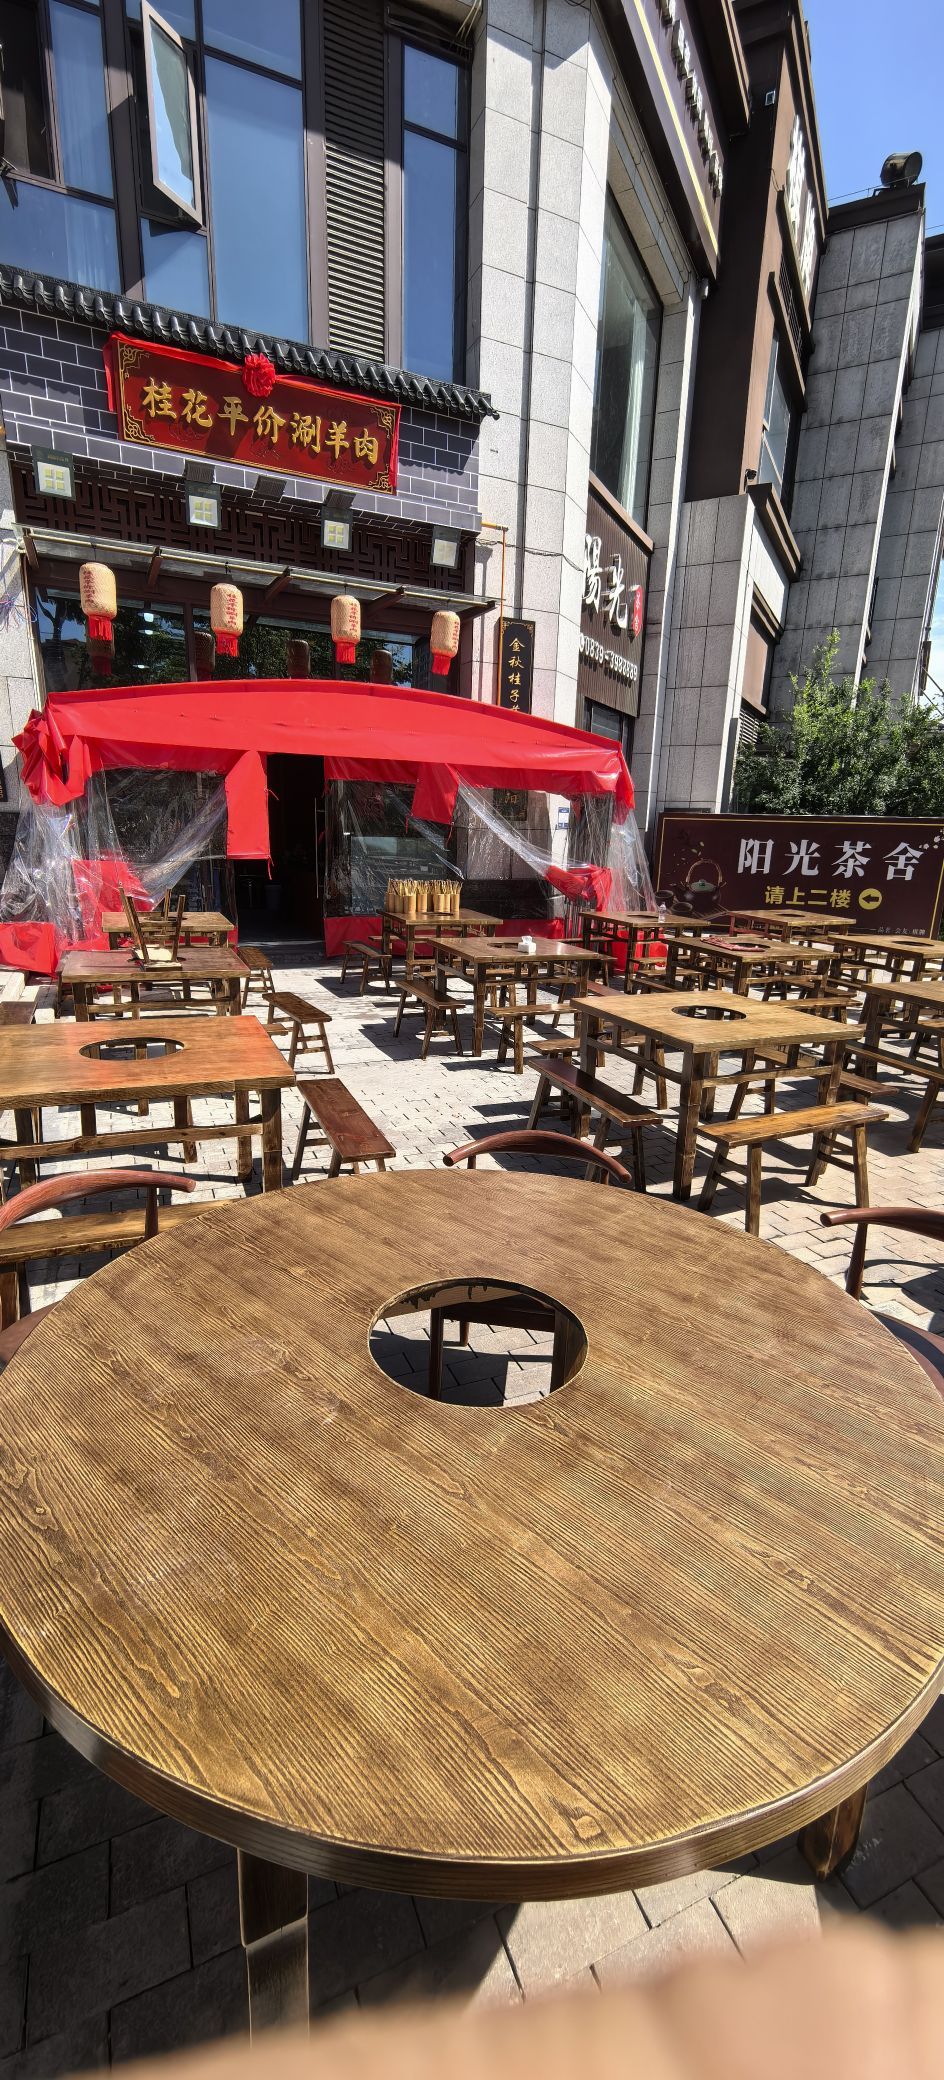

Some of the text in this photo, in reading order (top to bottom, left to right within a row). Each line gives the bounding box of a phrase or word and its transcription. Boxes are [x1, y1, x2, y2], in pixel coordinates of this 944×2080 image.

[142, 377, 379, 464] 桂花平价涮羊肉
[737, 838, 924, 881] 阳光茶舍
[764, 886, 852, 909] 请上二楼
